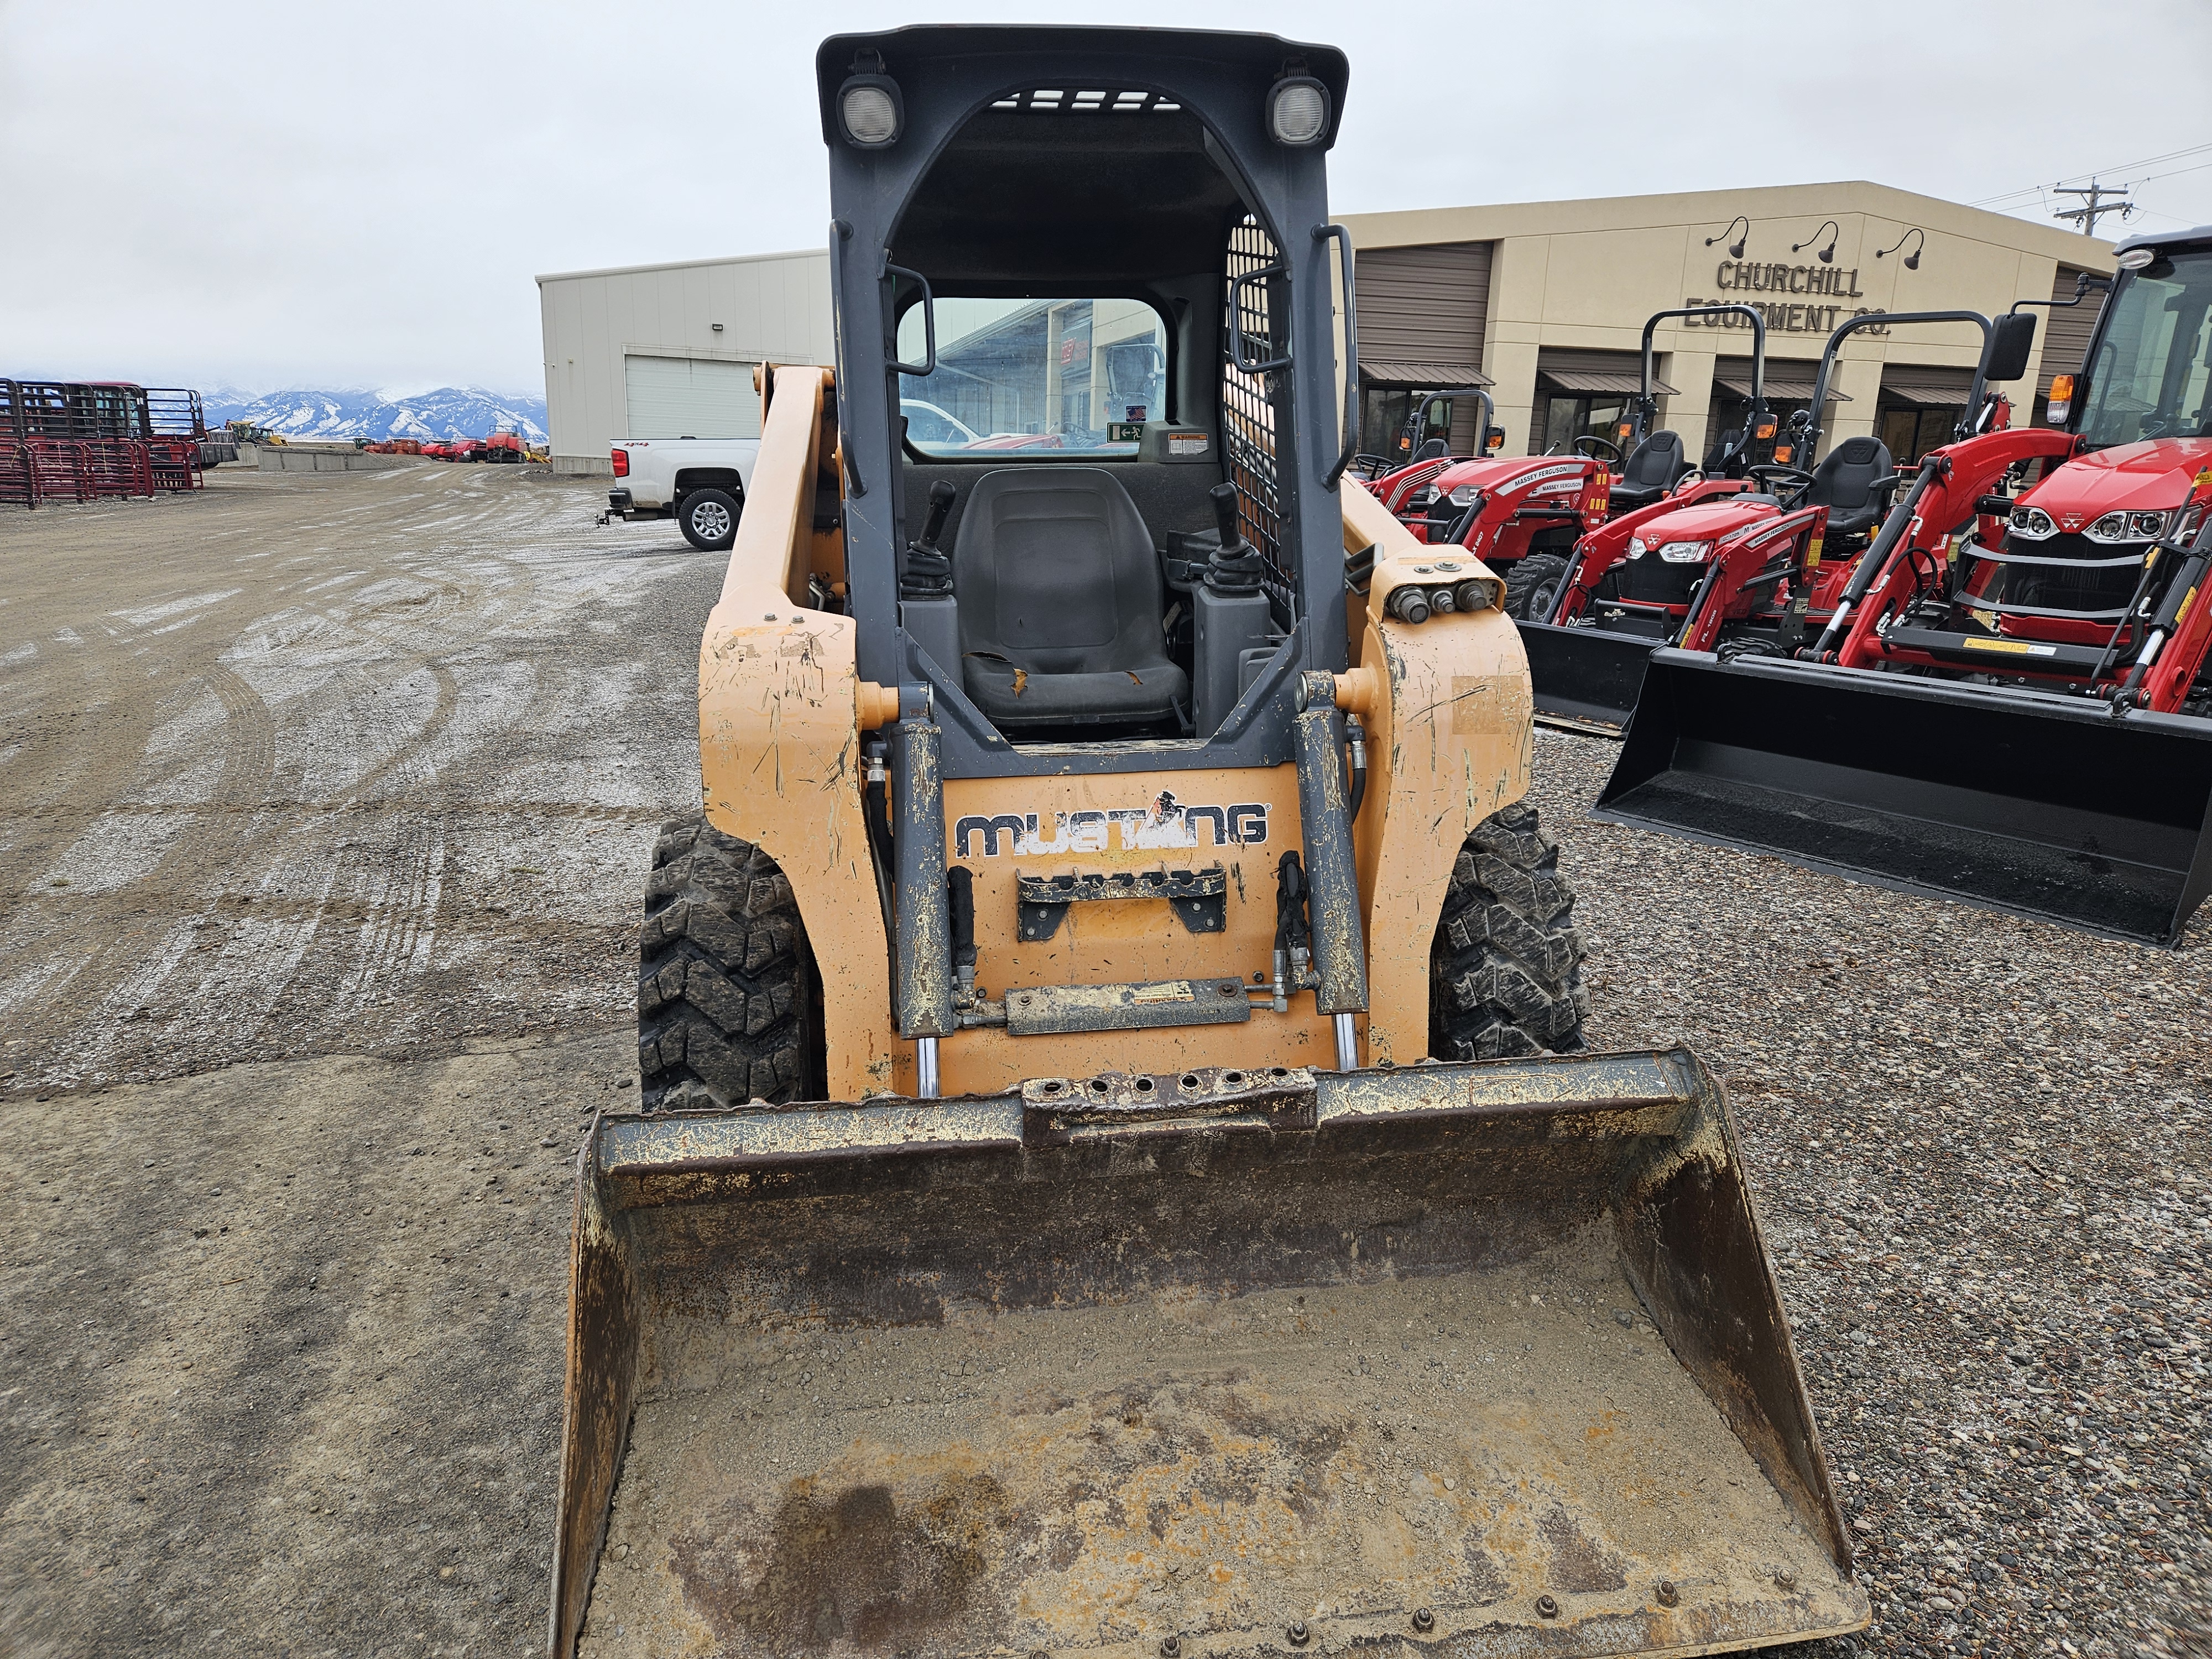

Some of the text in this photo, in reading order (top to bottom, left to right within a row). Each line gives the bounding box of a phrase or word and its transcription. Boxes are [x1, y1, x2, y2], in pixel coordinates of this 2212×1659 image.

[1718, 260, 1864, 297] CHURCHILL
[1684, 298, 1841, 332] EQUIPMENT
[1515, 466, 1567, 487] MASSEY FERGUSON
[1755, 523, 1790, 544] MASSEY FERGUSON
[1701, 630, 1709, 643] FL
[954, 792, 1270, 858] MUSTANG
